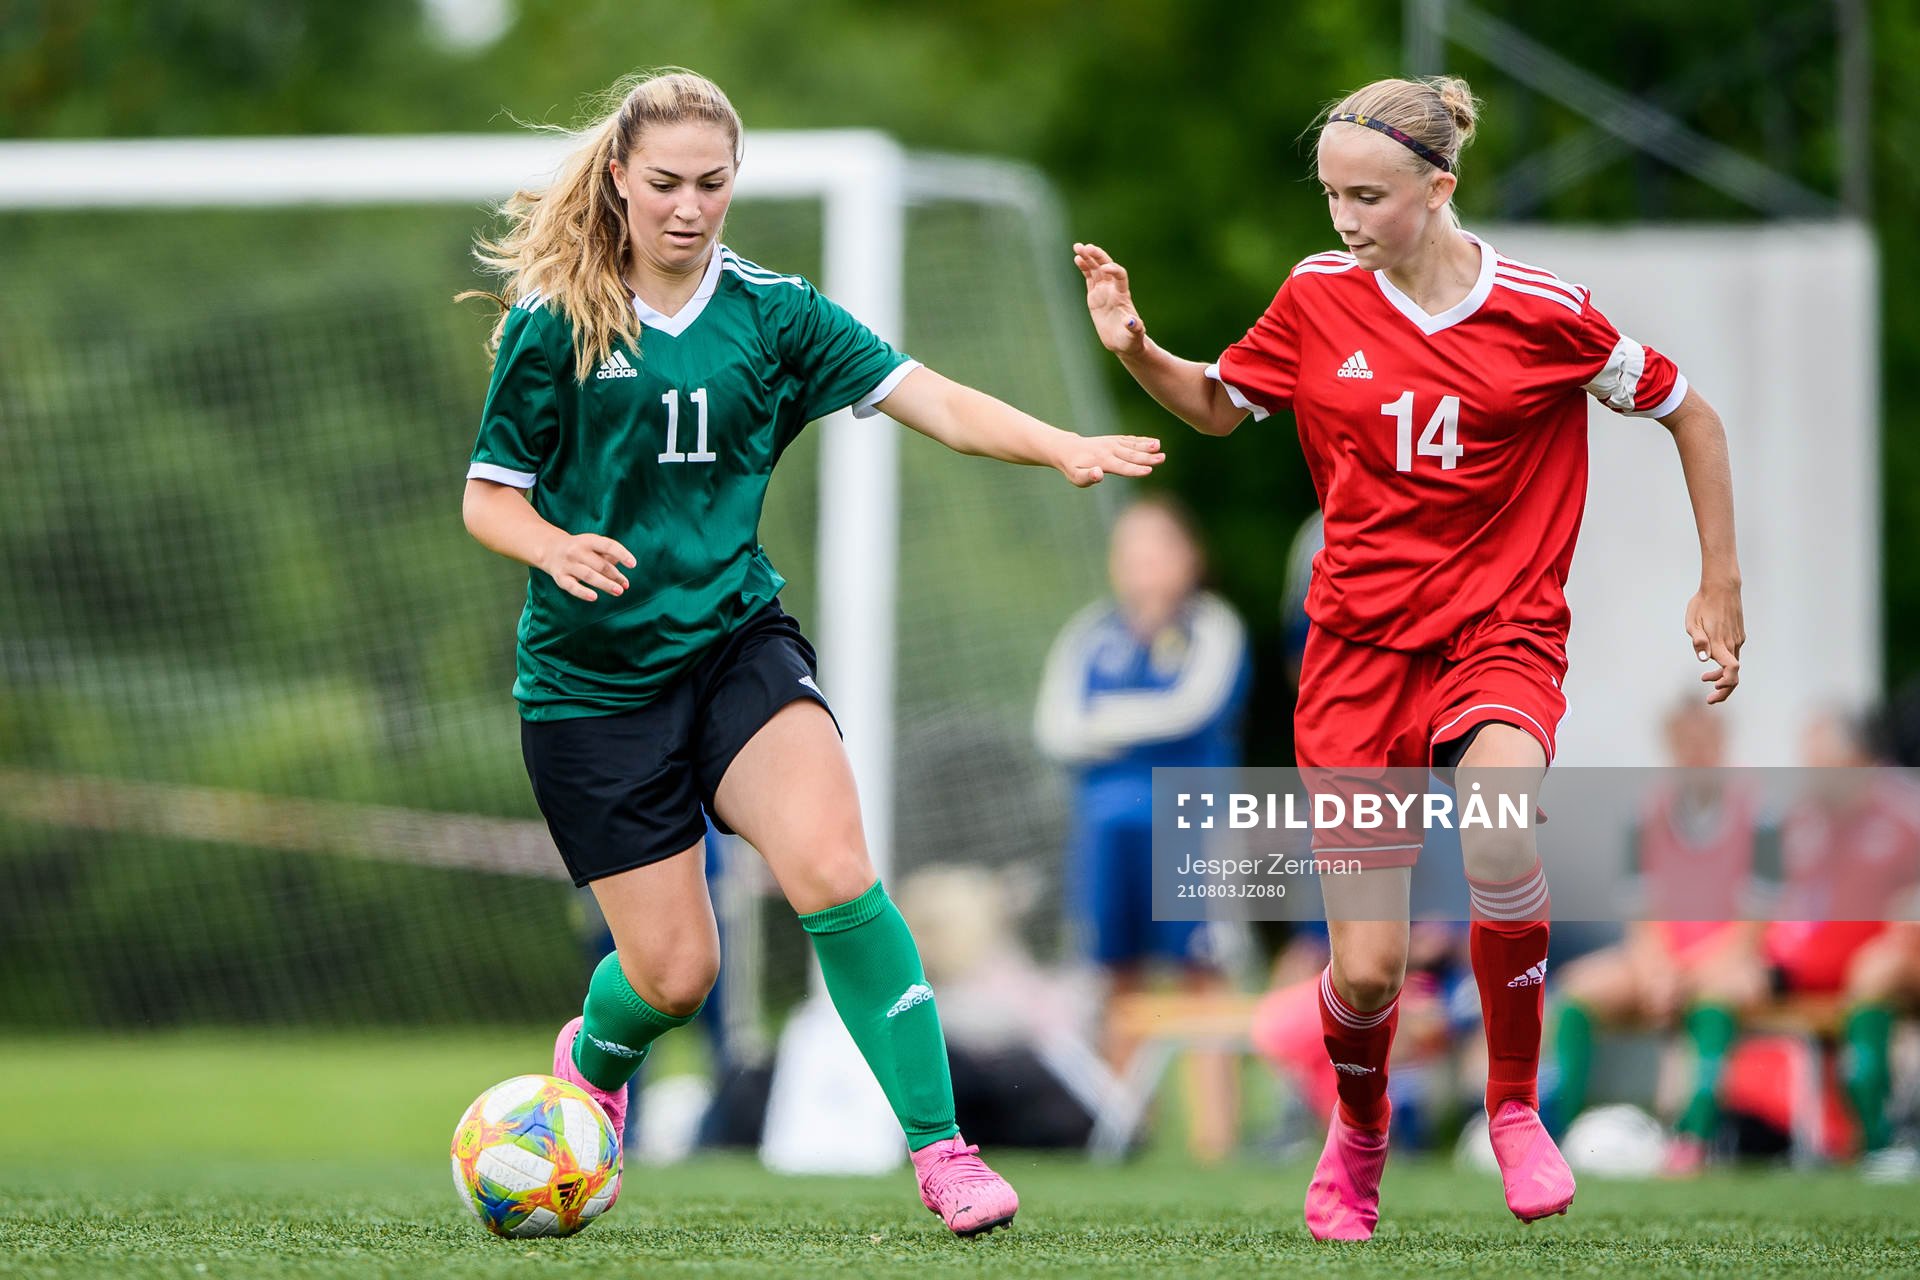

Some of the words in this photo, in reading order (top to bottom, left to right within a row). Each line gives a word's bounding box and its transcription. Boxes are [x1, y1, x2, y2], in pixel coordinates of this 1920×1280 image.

[597, 367, 638, 380] adidas
[1337, 368, 1373, 380] adidas
[658, 388, 717, 463] 11
[1381, 391, 1464, 472] 14
